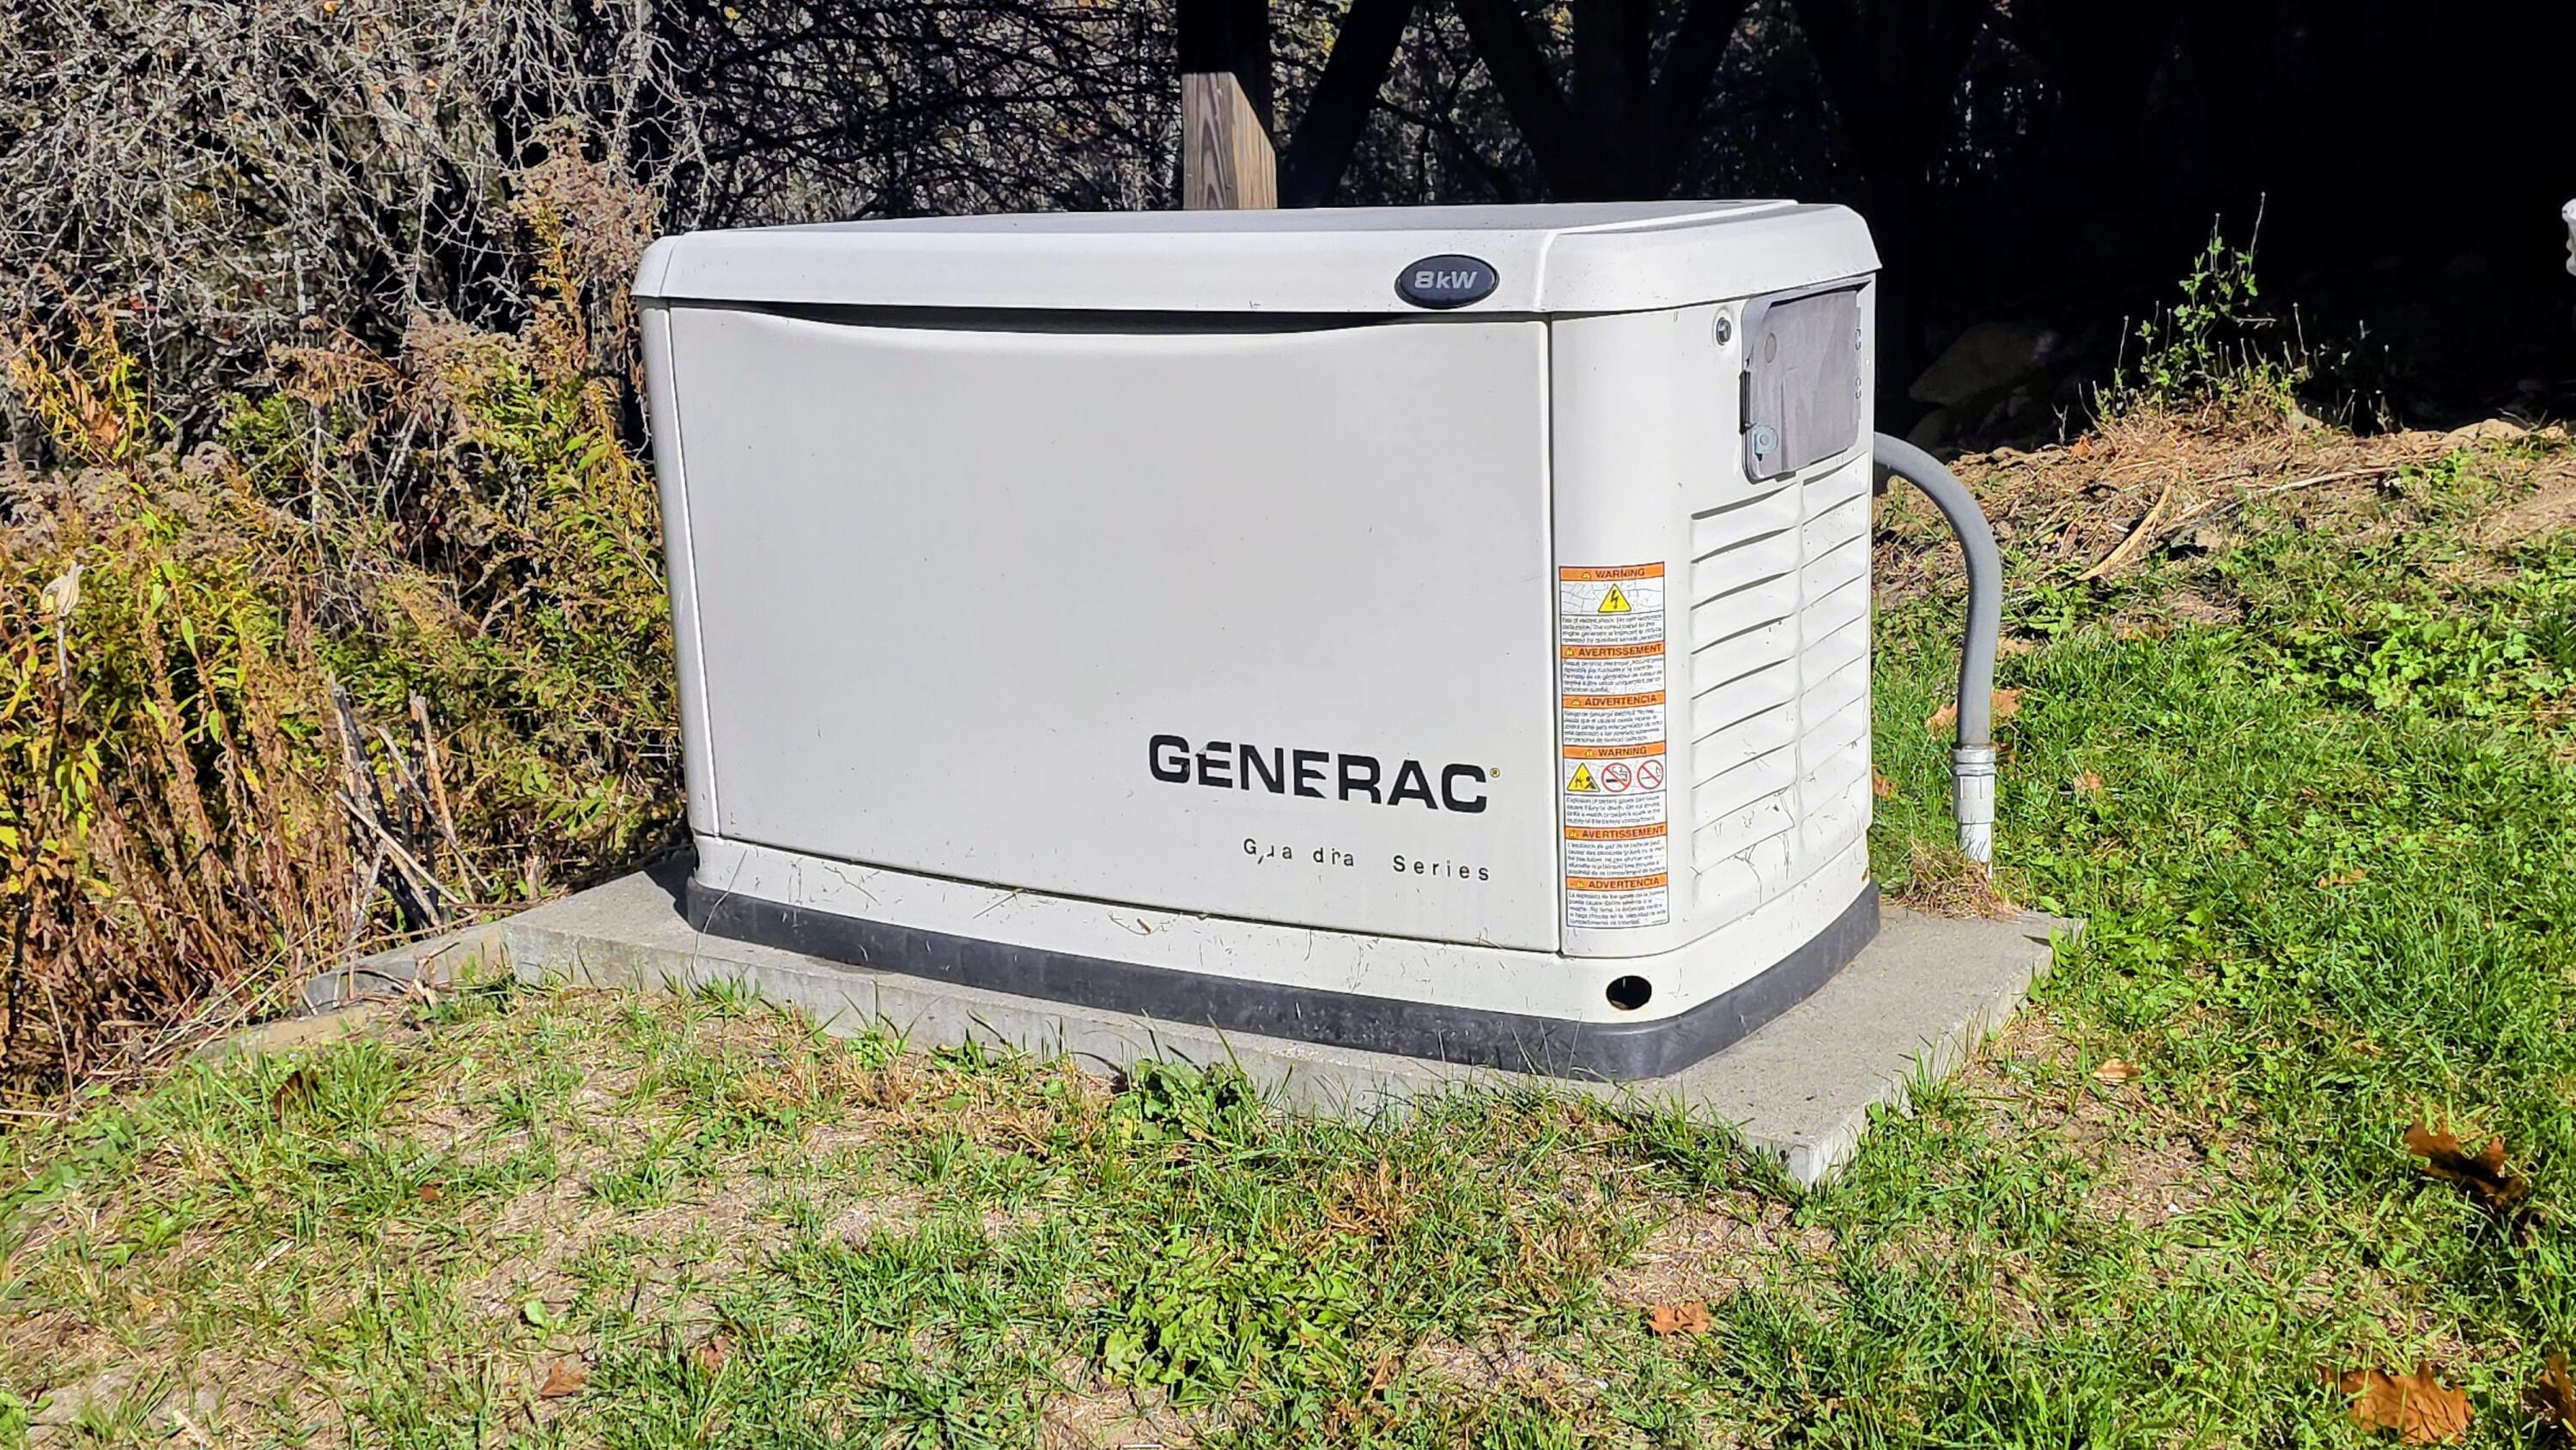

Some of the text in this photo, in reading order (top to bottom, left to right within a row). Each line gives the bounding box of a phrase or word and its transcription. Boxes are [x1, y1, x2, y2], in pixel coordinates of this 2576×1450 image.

[1414, 271, 1478, 289] 8kW
[1595, 567, 1645, 579] WARNING
[1578, 643, 1662, 657] AVERTISSEMENT
[1584, 695, 1657, 707] ADVERTENCIA
[1598, 746, 1647, 756] WARNING
[1149, 734, 1487, 813] GENERAC
[1582, 826, 1664, 839] AVERTISSEMENT
[1393, 855, 1490, 881] Series
[1589, 877, 1660, 889] ADVERTENCIA
